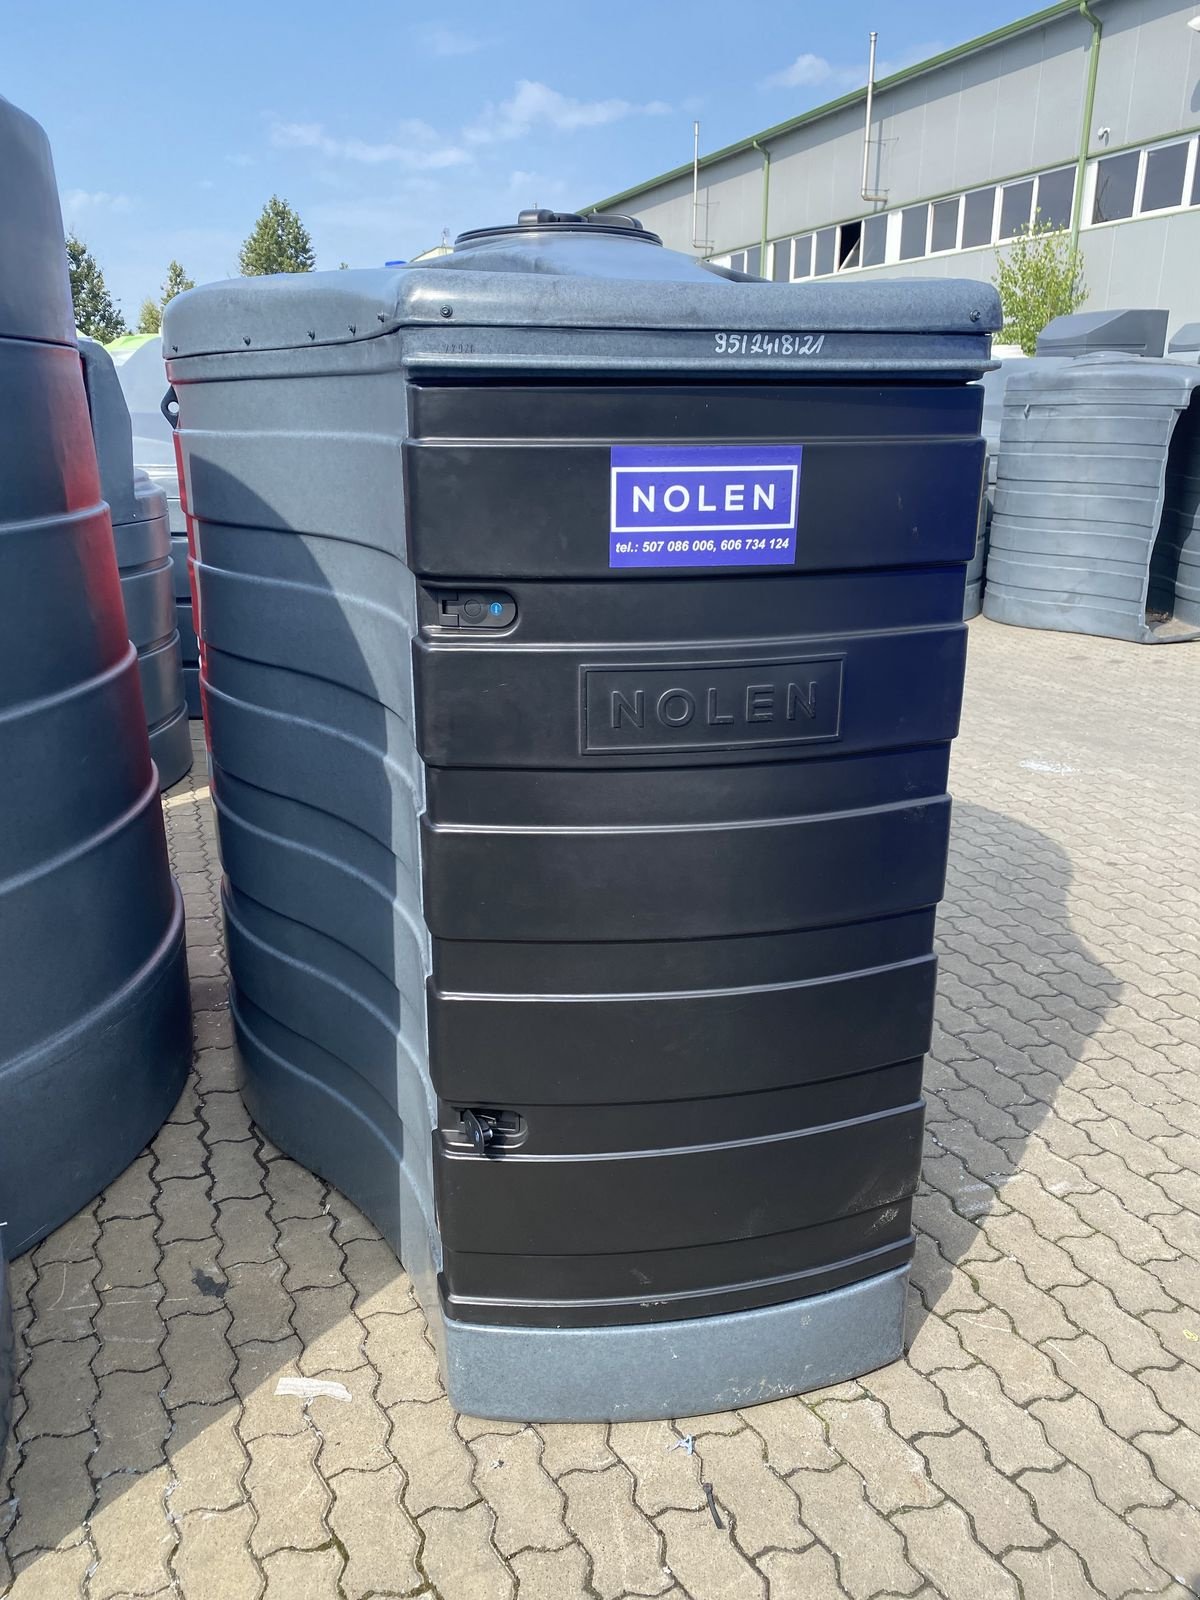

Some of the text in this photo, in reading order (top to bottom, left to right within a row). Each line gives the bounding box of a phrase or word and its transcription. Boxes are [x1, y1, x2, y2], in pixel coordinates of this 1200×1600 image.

[631, 483, 775, 513] NOLEN
[615, 537, 790, 553] tel.: 507 086 006, 606 734 124
[611, 681, 817, 729] NOLEN
